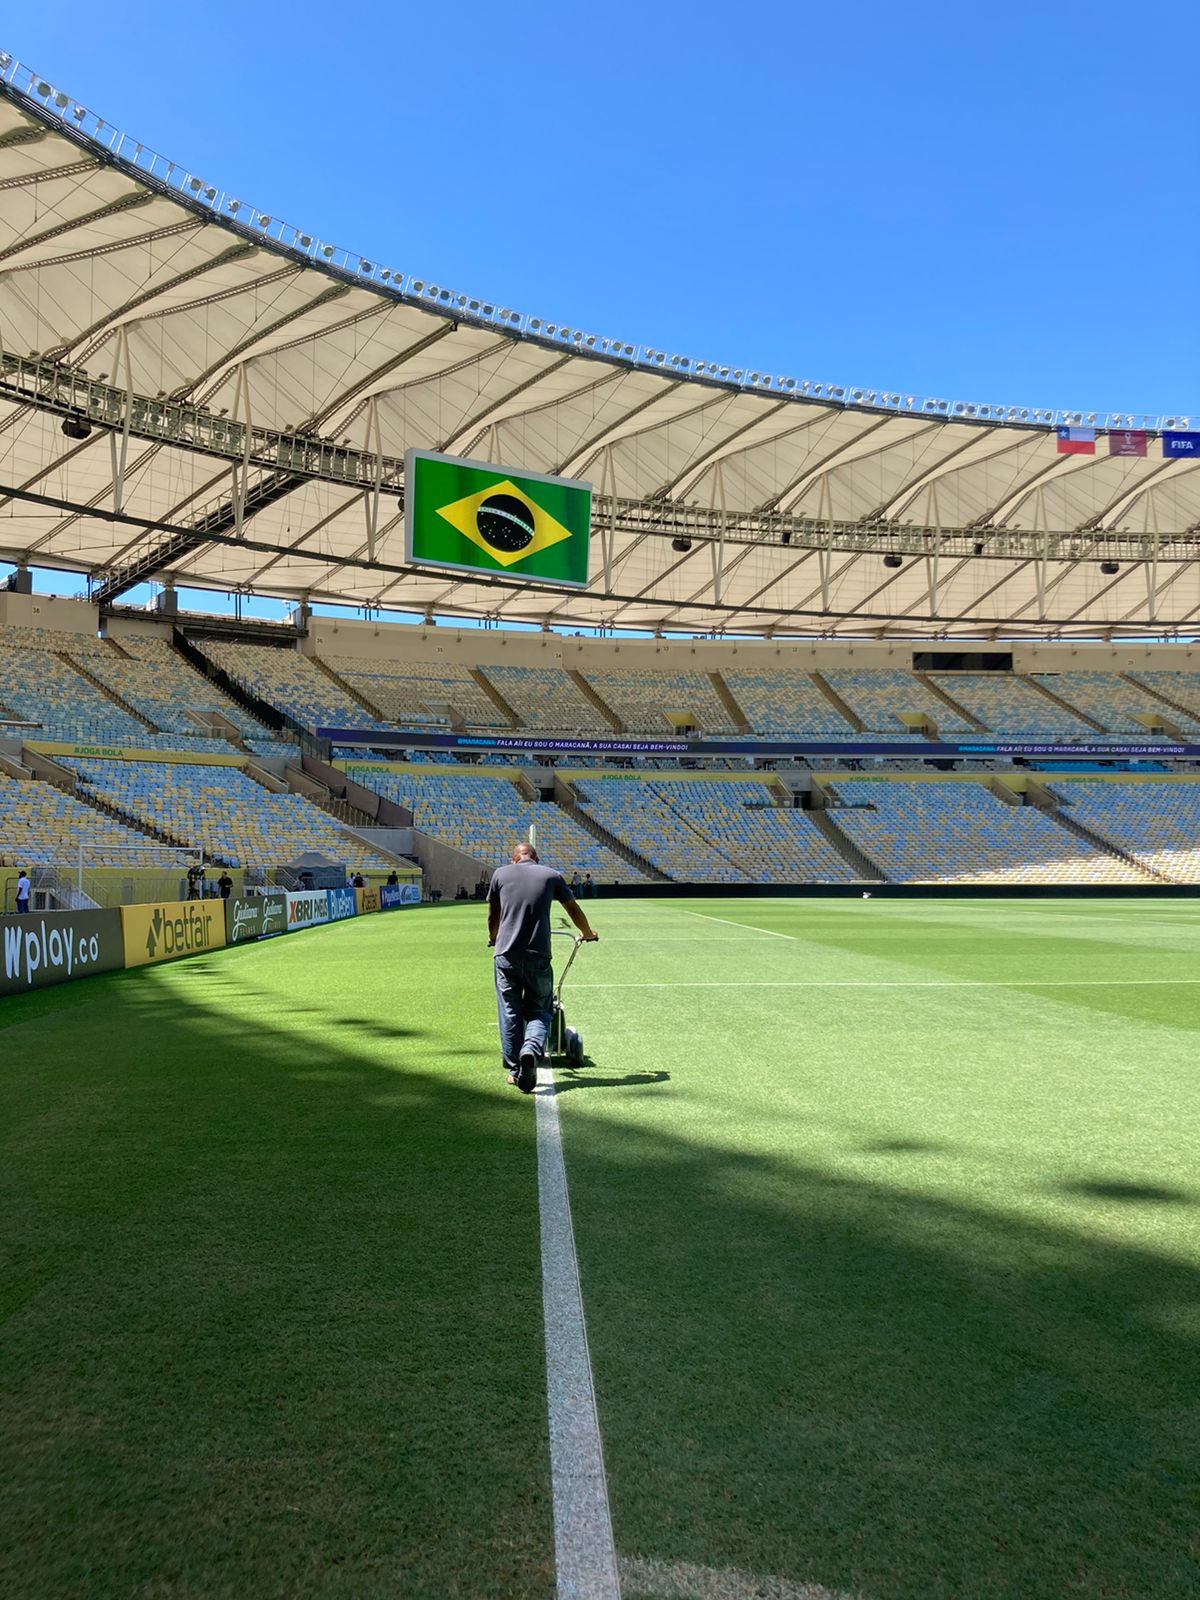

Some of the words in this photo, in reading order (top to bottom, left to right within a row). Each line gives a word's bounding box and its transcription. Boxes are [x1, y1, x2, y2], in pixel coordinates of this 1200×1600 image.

[1171, 440, 1193, 449] FIFA
[163, 905, 212, 953] betfair
[289, 899, 313, 923] XBRI
[4, 920, 99, 984] Wplay.co
